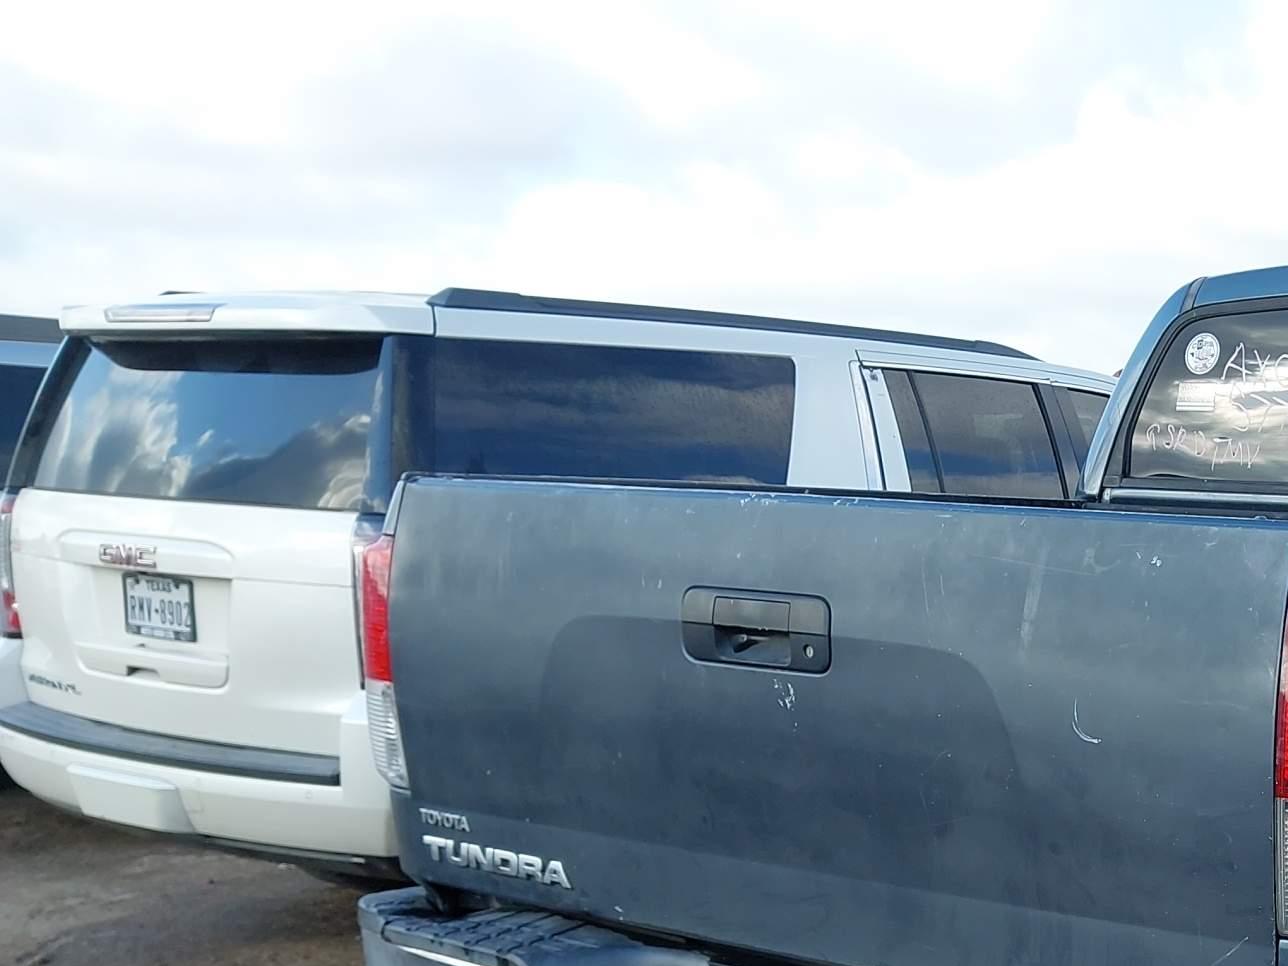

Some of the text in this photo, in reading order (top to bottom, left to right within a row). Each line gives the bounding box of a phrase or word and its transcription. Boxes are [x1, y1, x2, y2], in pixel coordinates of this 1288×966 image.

[100, 543, 157, 569] GMC
[144, 579, 173, 592] TEXAS
[419, 807, 471, 832] TOYOTA
[422, 834, 573, 889] TUNDRA
